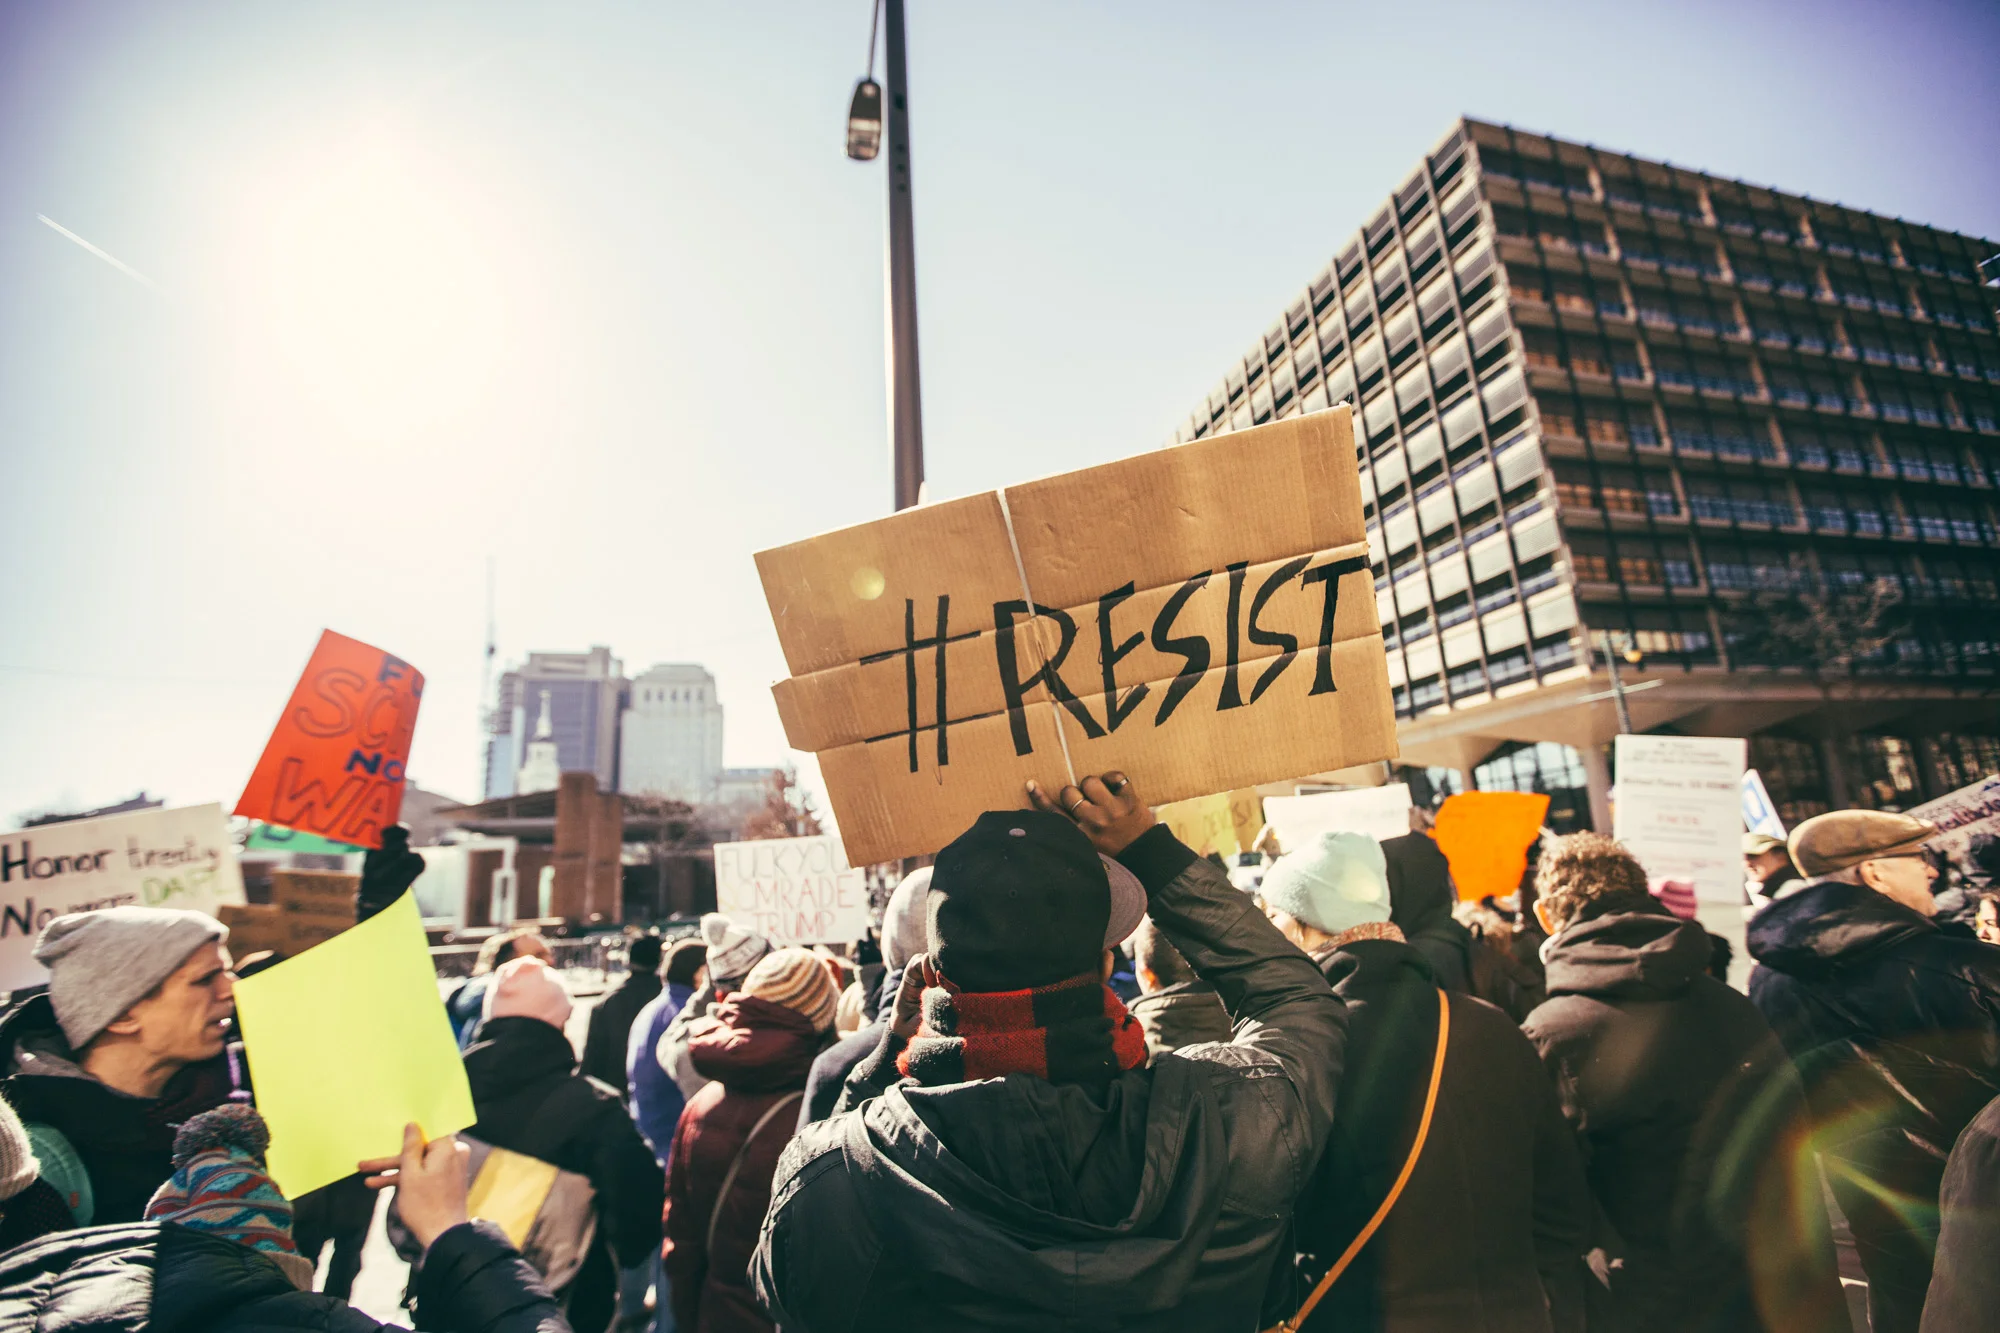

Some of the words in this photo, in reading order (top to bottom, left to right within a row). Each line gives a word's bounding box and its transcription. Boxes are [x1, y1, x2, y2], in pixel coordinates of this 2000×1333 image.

[860, 555, 1372, 774] #RESIST
[1, 838, 117, 883] Honor
[720, 846, 793, 880] FUCK
[752, 909, 836, 942] TRUMP
